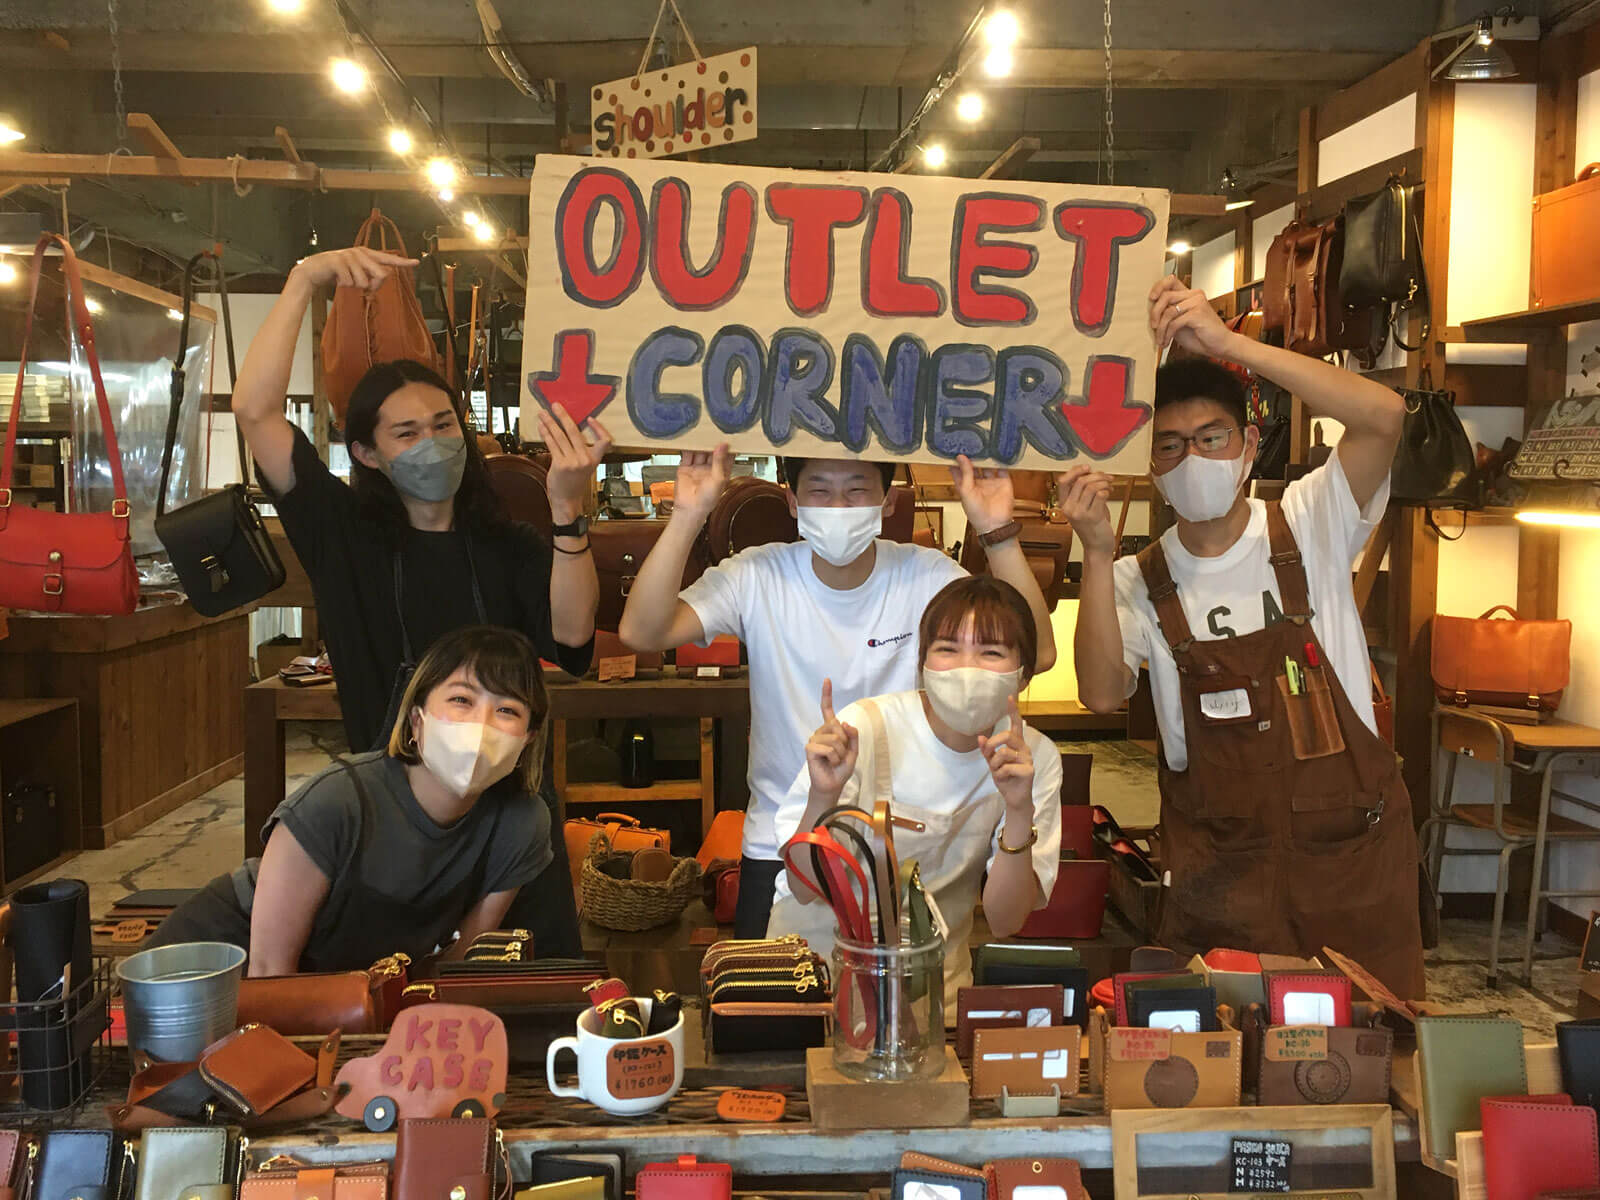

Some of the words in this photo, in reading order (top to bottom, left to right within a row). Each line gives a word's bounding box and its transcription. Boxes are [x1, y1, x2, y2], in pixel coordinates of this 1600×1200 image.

[594, 87, 748, 151] shoulder
[555, 166, 1156, 338] OUTLET
[626, 324, 1078, 465] CORNER
[867, 632, 913, 648] Champion
[406, 1014, 495, 1053] KEY
[380, 1053, 493, 1093] CASE
[1236, 1167, 1245, 1177] N
